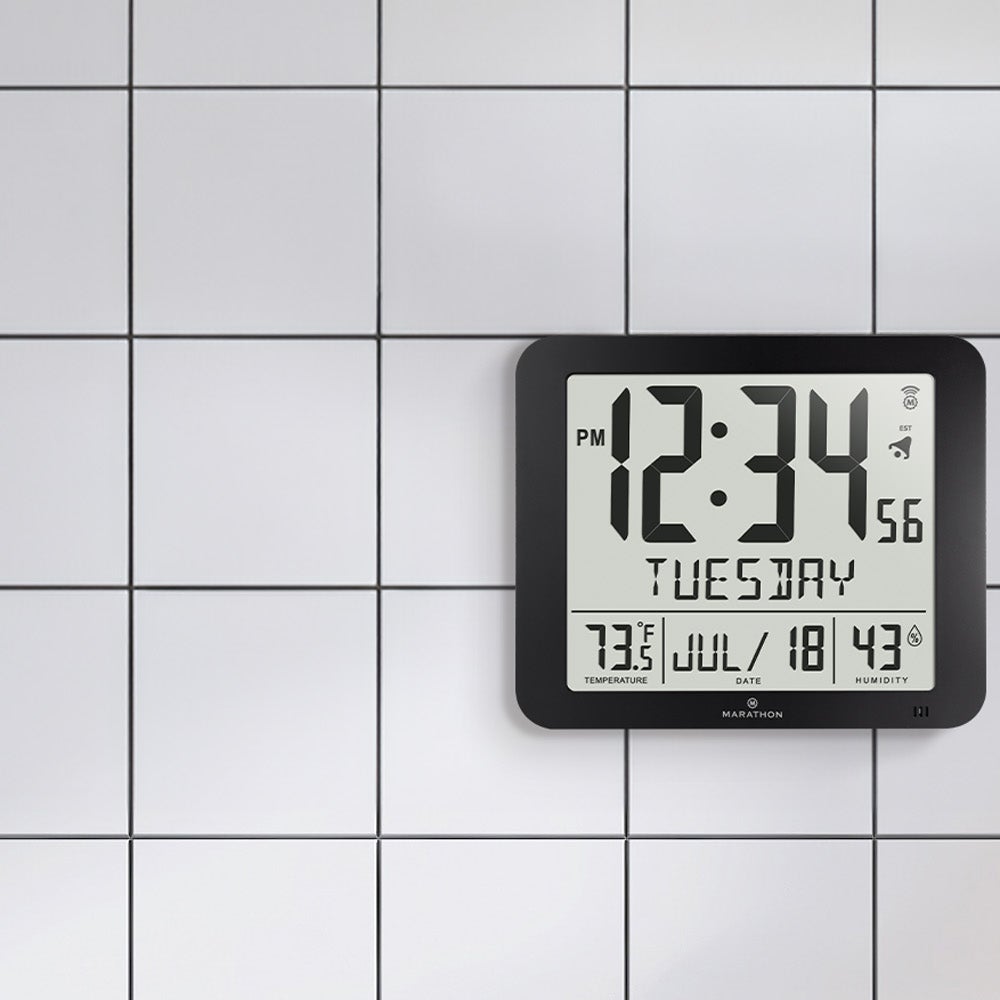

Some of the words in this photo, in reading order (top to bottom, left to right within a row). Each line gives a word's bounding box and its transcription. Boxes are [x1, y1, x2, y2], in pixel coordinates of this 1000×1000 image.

[576, 428, 606, 446] PM
[610, 385, 868, 543] 12:34
[877, 498, 923, 543] 56
[645, 558, 855, 600] TUESDAY
[853, 624, 901, 671] 43
[584, 676, 648, 684] TEMPERATURE
[736, 677, 761, 685] DATE
[855, 676, 908, 684] HUMIDITY
[722, 710, 783, 718] MARATHON
